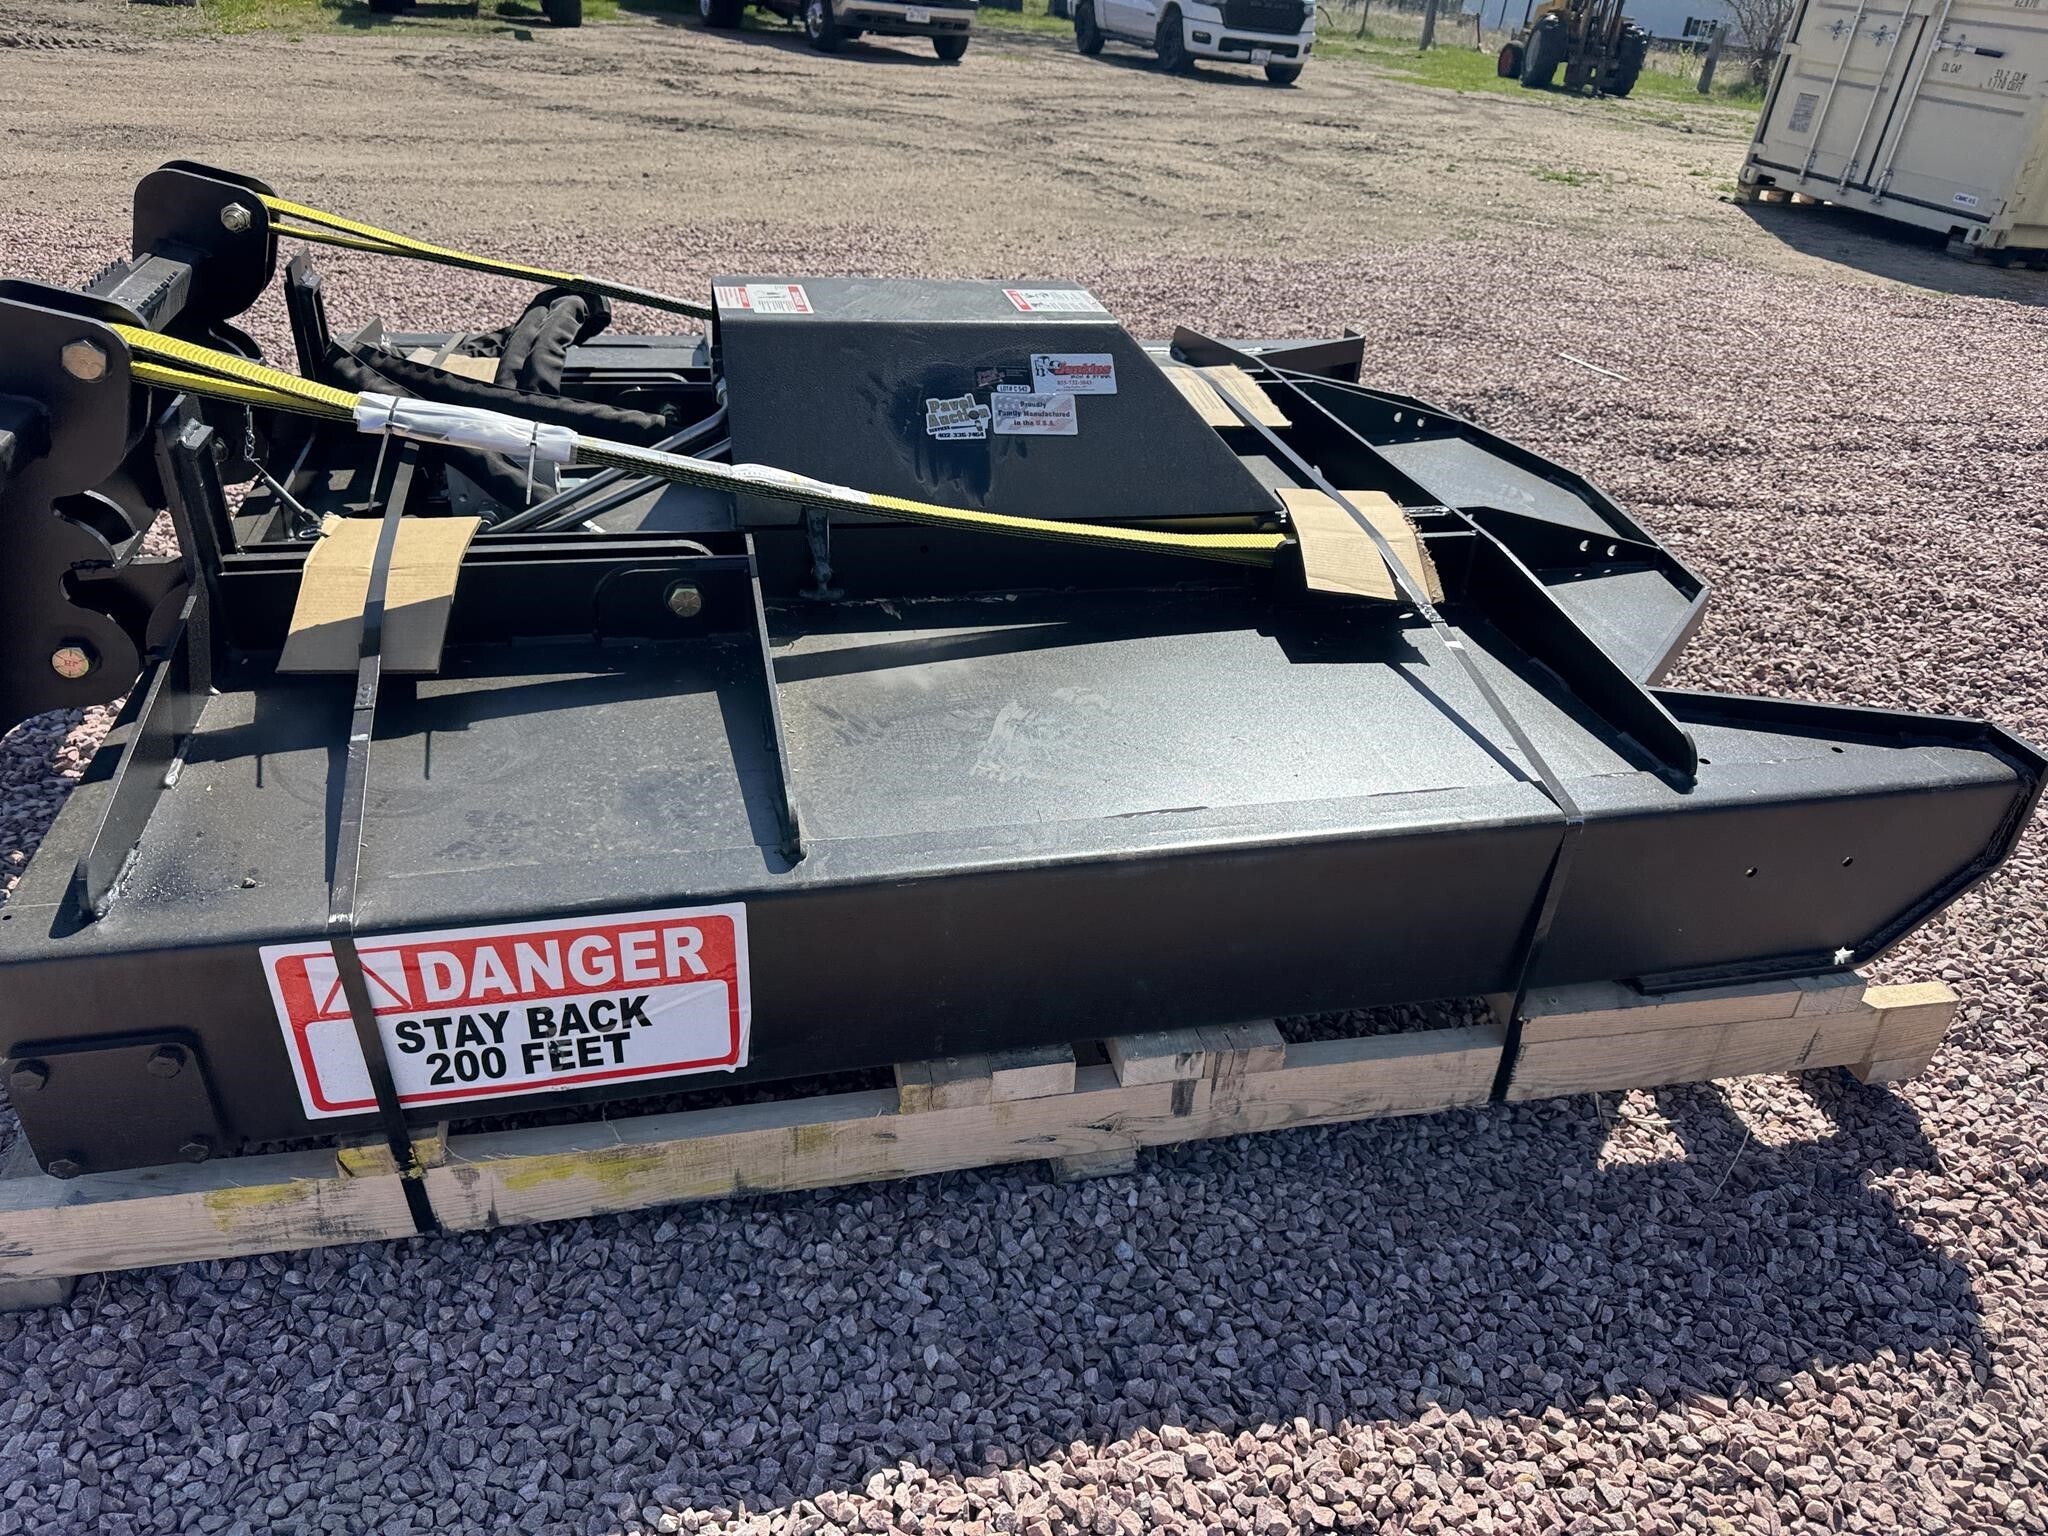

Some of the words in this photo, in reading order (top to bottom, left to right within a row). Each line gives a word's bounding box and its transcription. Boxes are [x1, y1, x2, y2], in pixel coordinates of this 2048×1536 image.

[1055, 361, 1112, 375] Jenkins
[928, 395, 976, 413] Pavel
[998, 409, 1021, 418] Family
[1023, 410, 1071, 418] Manufactured
[1019, 401, 1046, 409] Proudly
[928, 407, 989, 428] Auction
[417, 925, 709, 1003] DANGER
[395, 1010, 510, 1054] STAY
[527, 994, 653, 1039] BACK
[426, 1046, 508, 1086] 200
[520, 1031, 632, 1075] FEET
